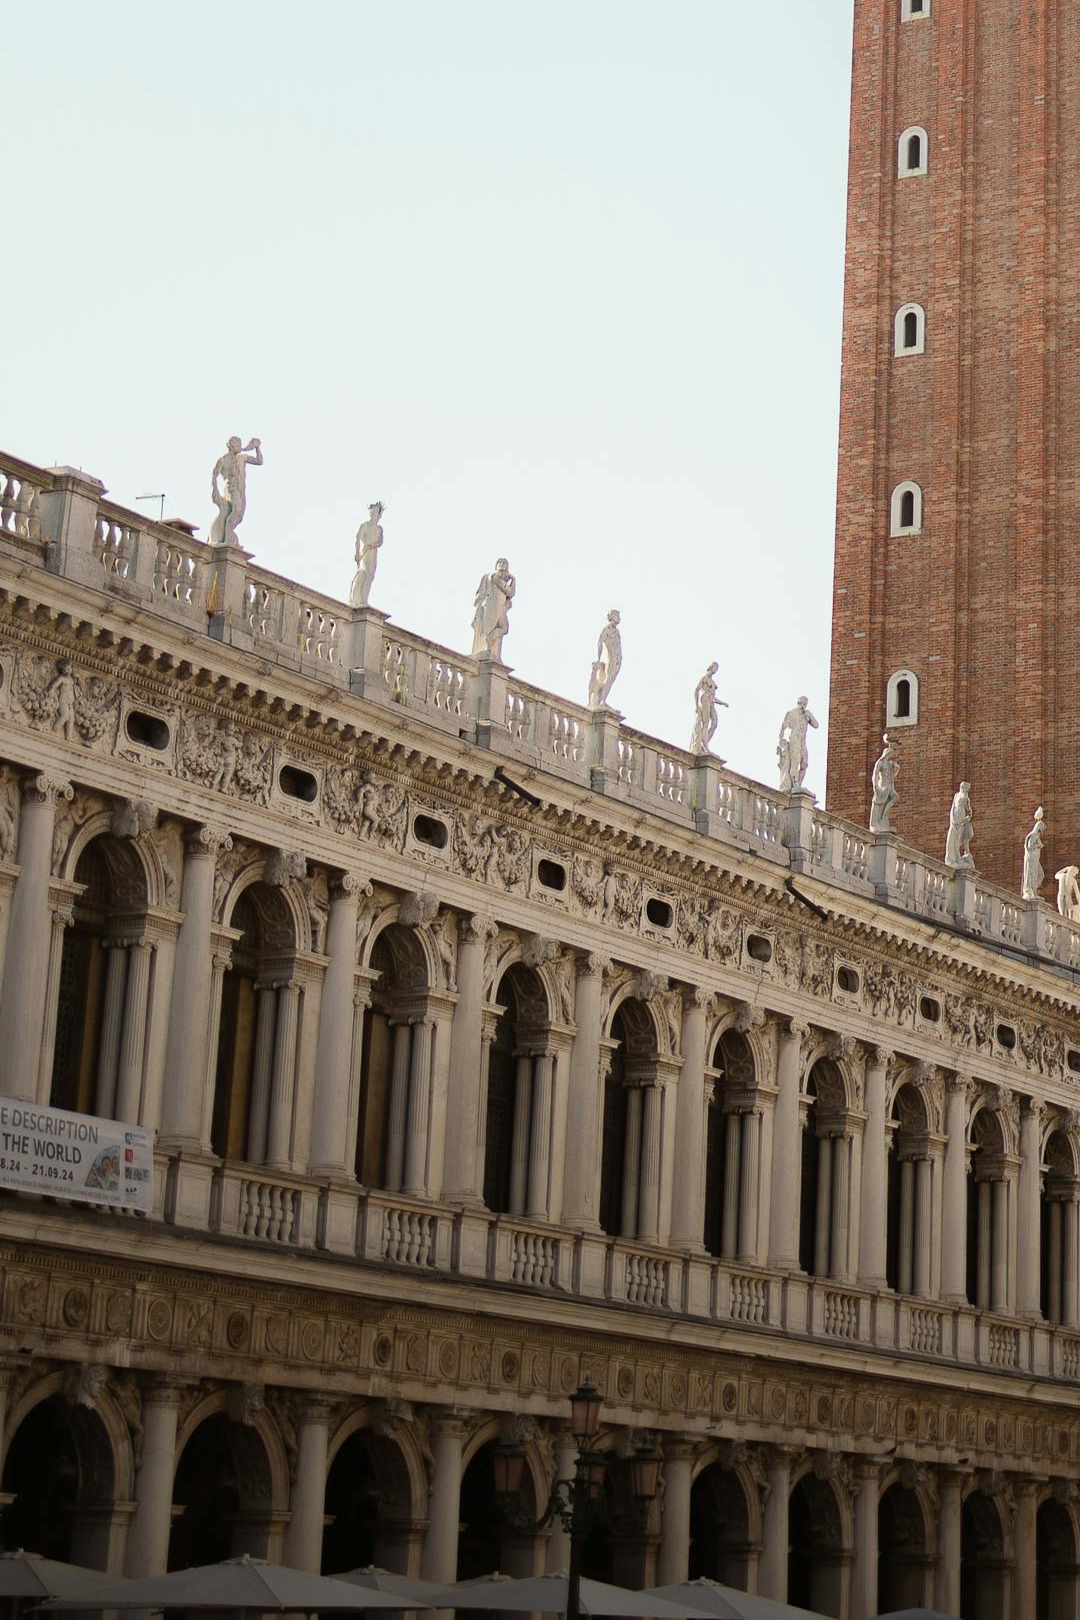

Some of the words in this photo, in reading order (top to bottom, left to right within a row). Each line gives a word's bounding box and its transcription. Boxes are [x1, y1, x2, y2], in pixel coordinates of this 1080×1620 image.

[12, 1109, 98, 1144] DESCRIPTION
[2, 1132, 29, 1154] THE
[33, 1138, 82, 1164] WORLD
[32, 1164, 74, 1181] 21.09.24
